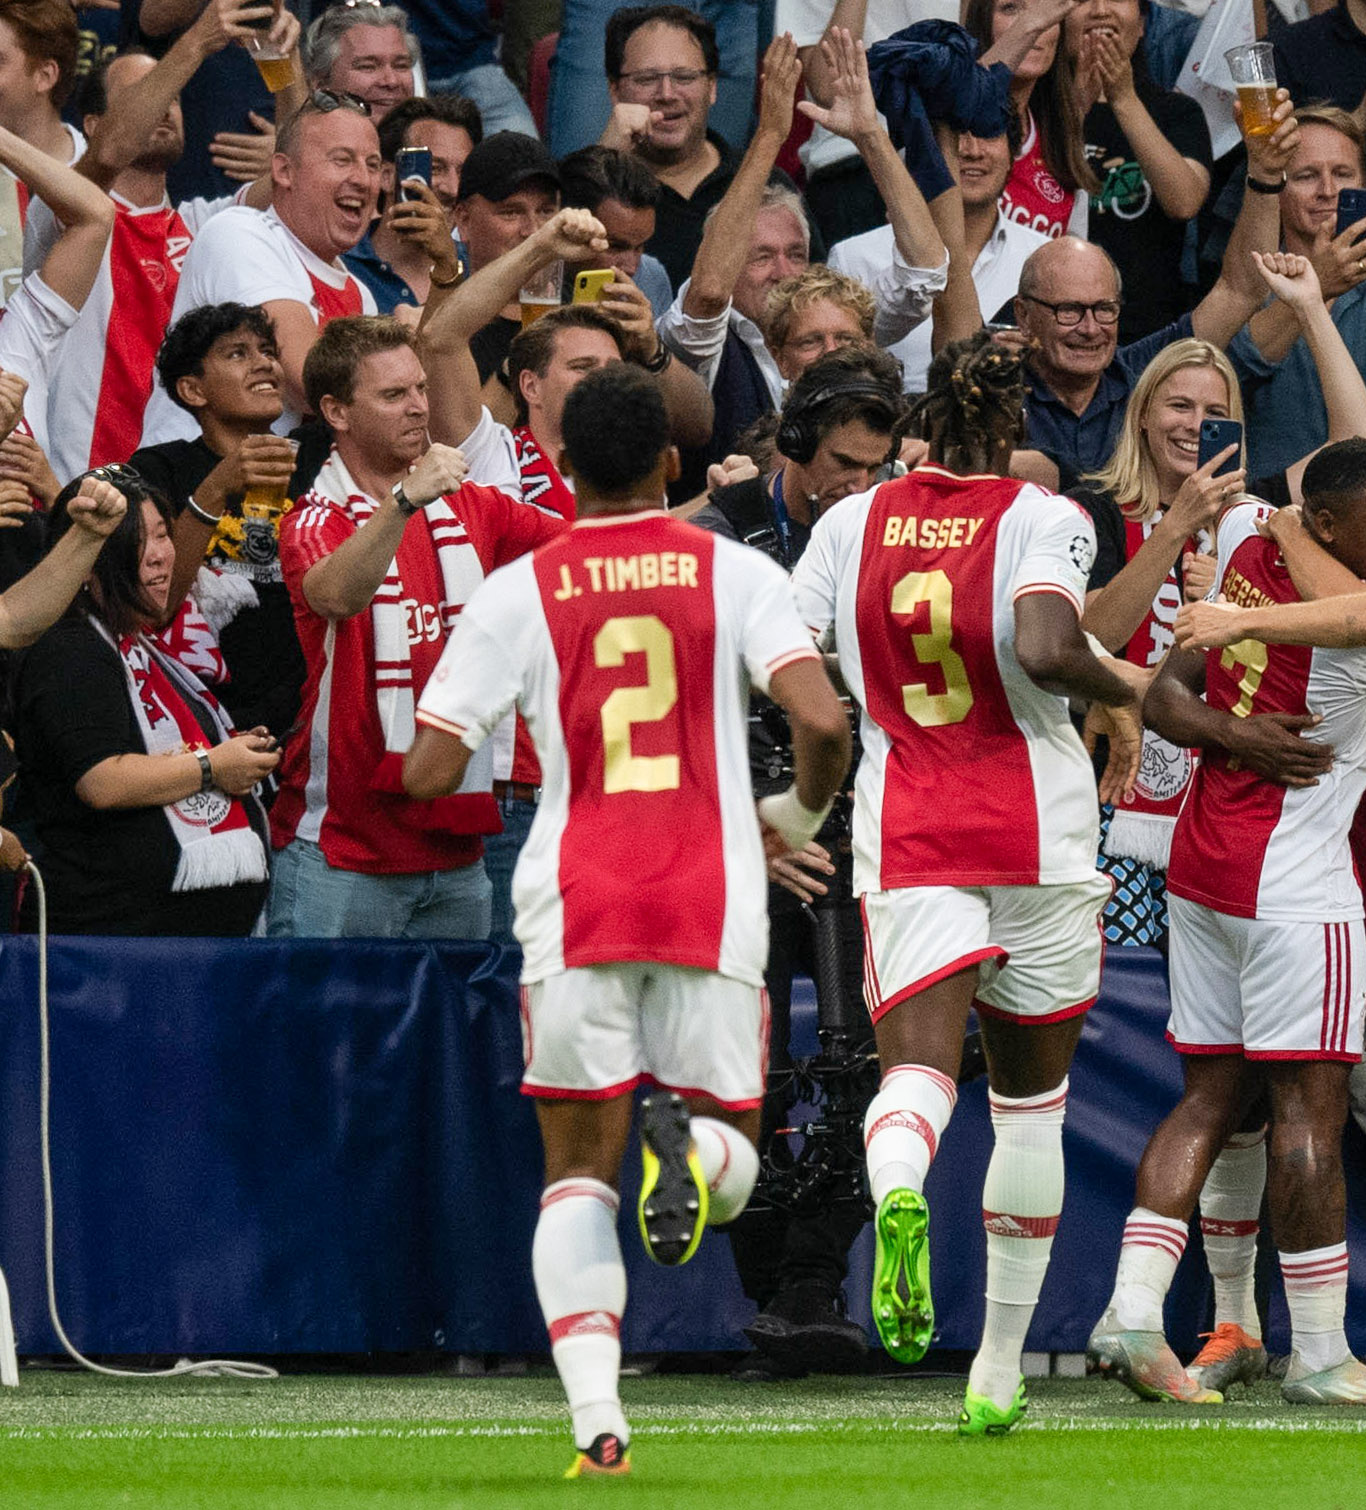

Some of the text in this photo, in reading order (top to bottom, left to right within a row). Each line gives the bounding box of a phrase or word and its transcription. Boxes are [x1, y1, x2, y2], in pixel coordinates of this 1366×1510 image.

[883, 516, 984, 549] BASSEY
[554, 552, 699, 601] J. TIMBER
[890, 568, 974, 727] 3
[1221, 638, 1269, 719] 7
[593, 614, 680, 795] 2
